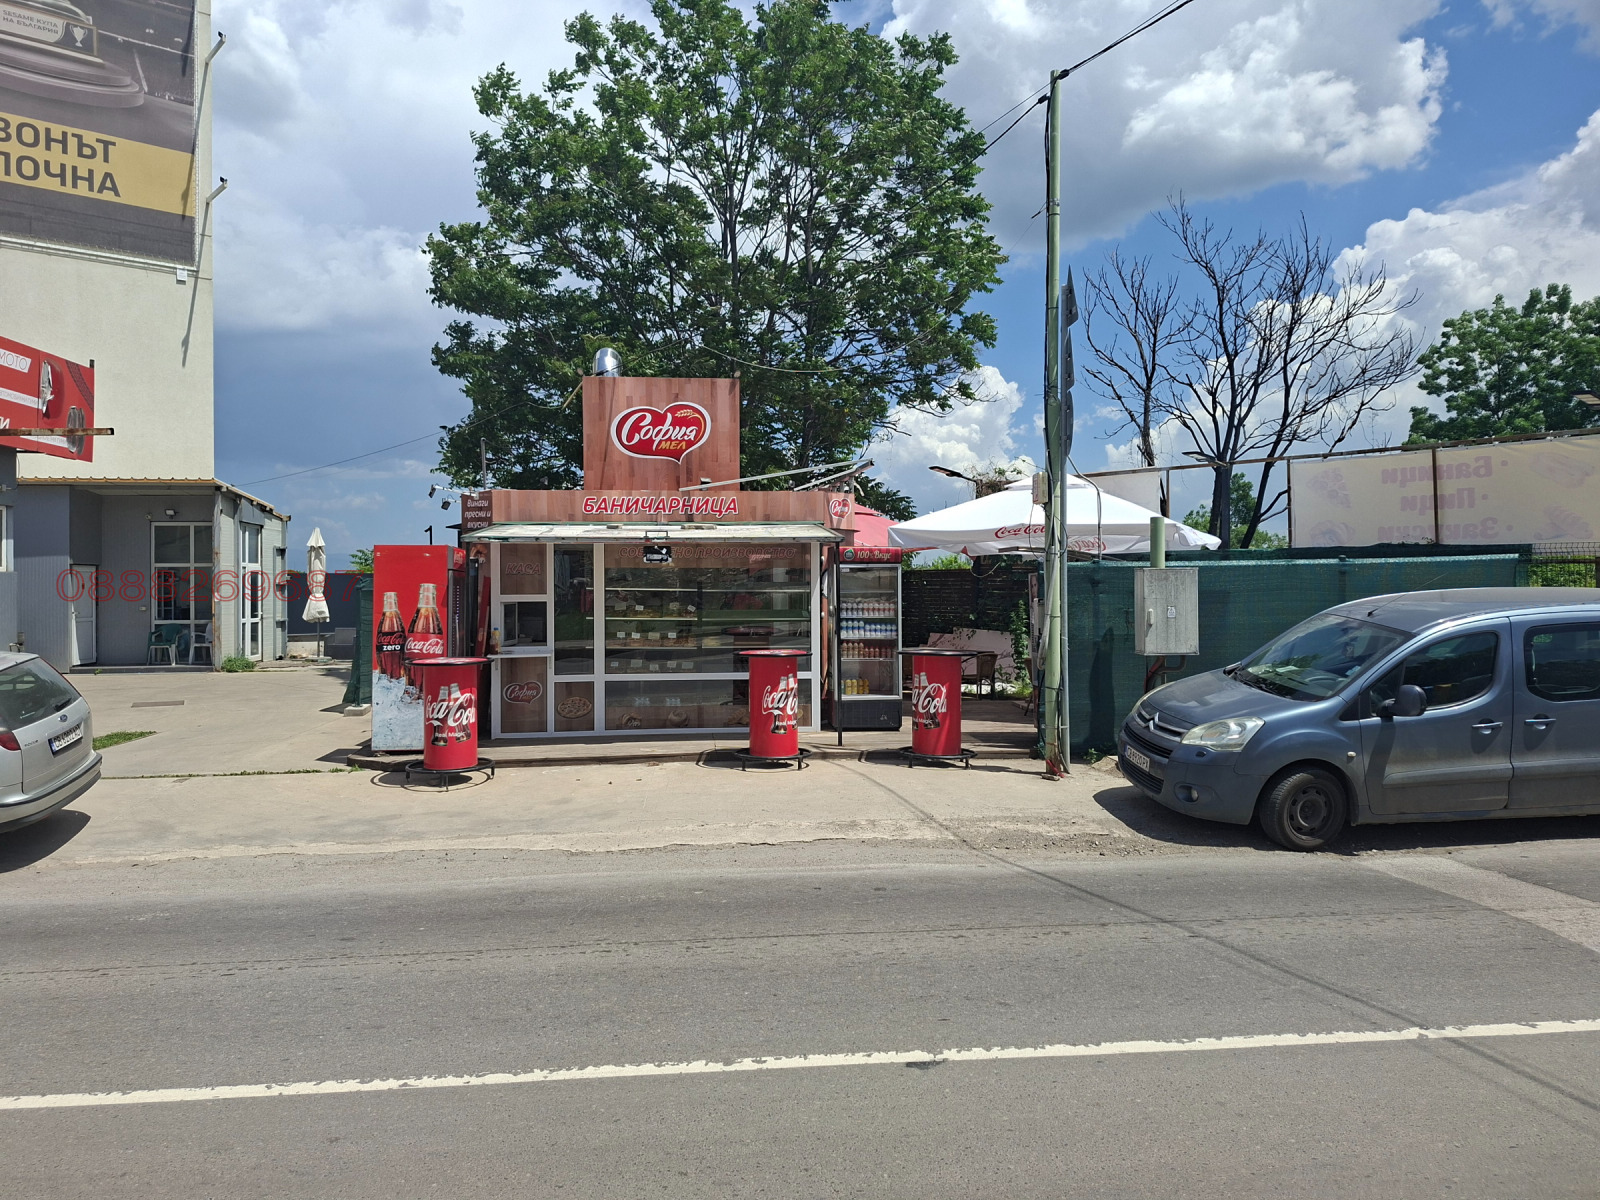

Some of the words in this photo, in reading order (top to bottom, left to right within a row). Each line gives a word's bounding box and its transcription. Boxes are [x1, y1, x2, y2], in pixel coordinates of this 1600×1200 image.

[2, 10, 35, 22] SESAME
[36, 18, 59, 28] КУПА
[16, 20, 59, 35] БЪЛГАРИЯ
[621, 412, 698, 451] София
[658, 440, 686, 450] МЕЛ
[583, 496, 738, 518] БАНИЧАРНИЦА
[619, 547, 693, 558] СОБНО
[695, 547, 796, 558] ПРОИЗВОДСТВО
[506, 563, 541, 574] КАСА
[405, 637, 443, 655] Coca-Cola
